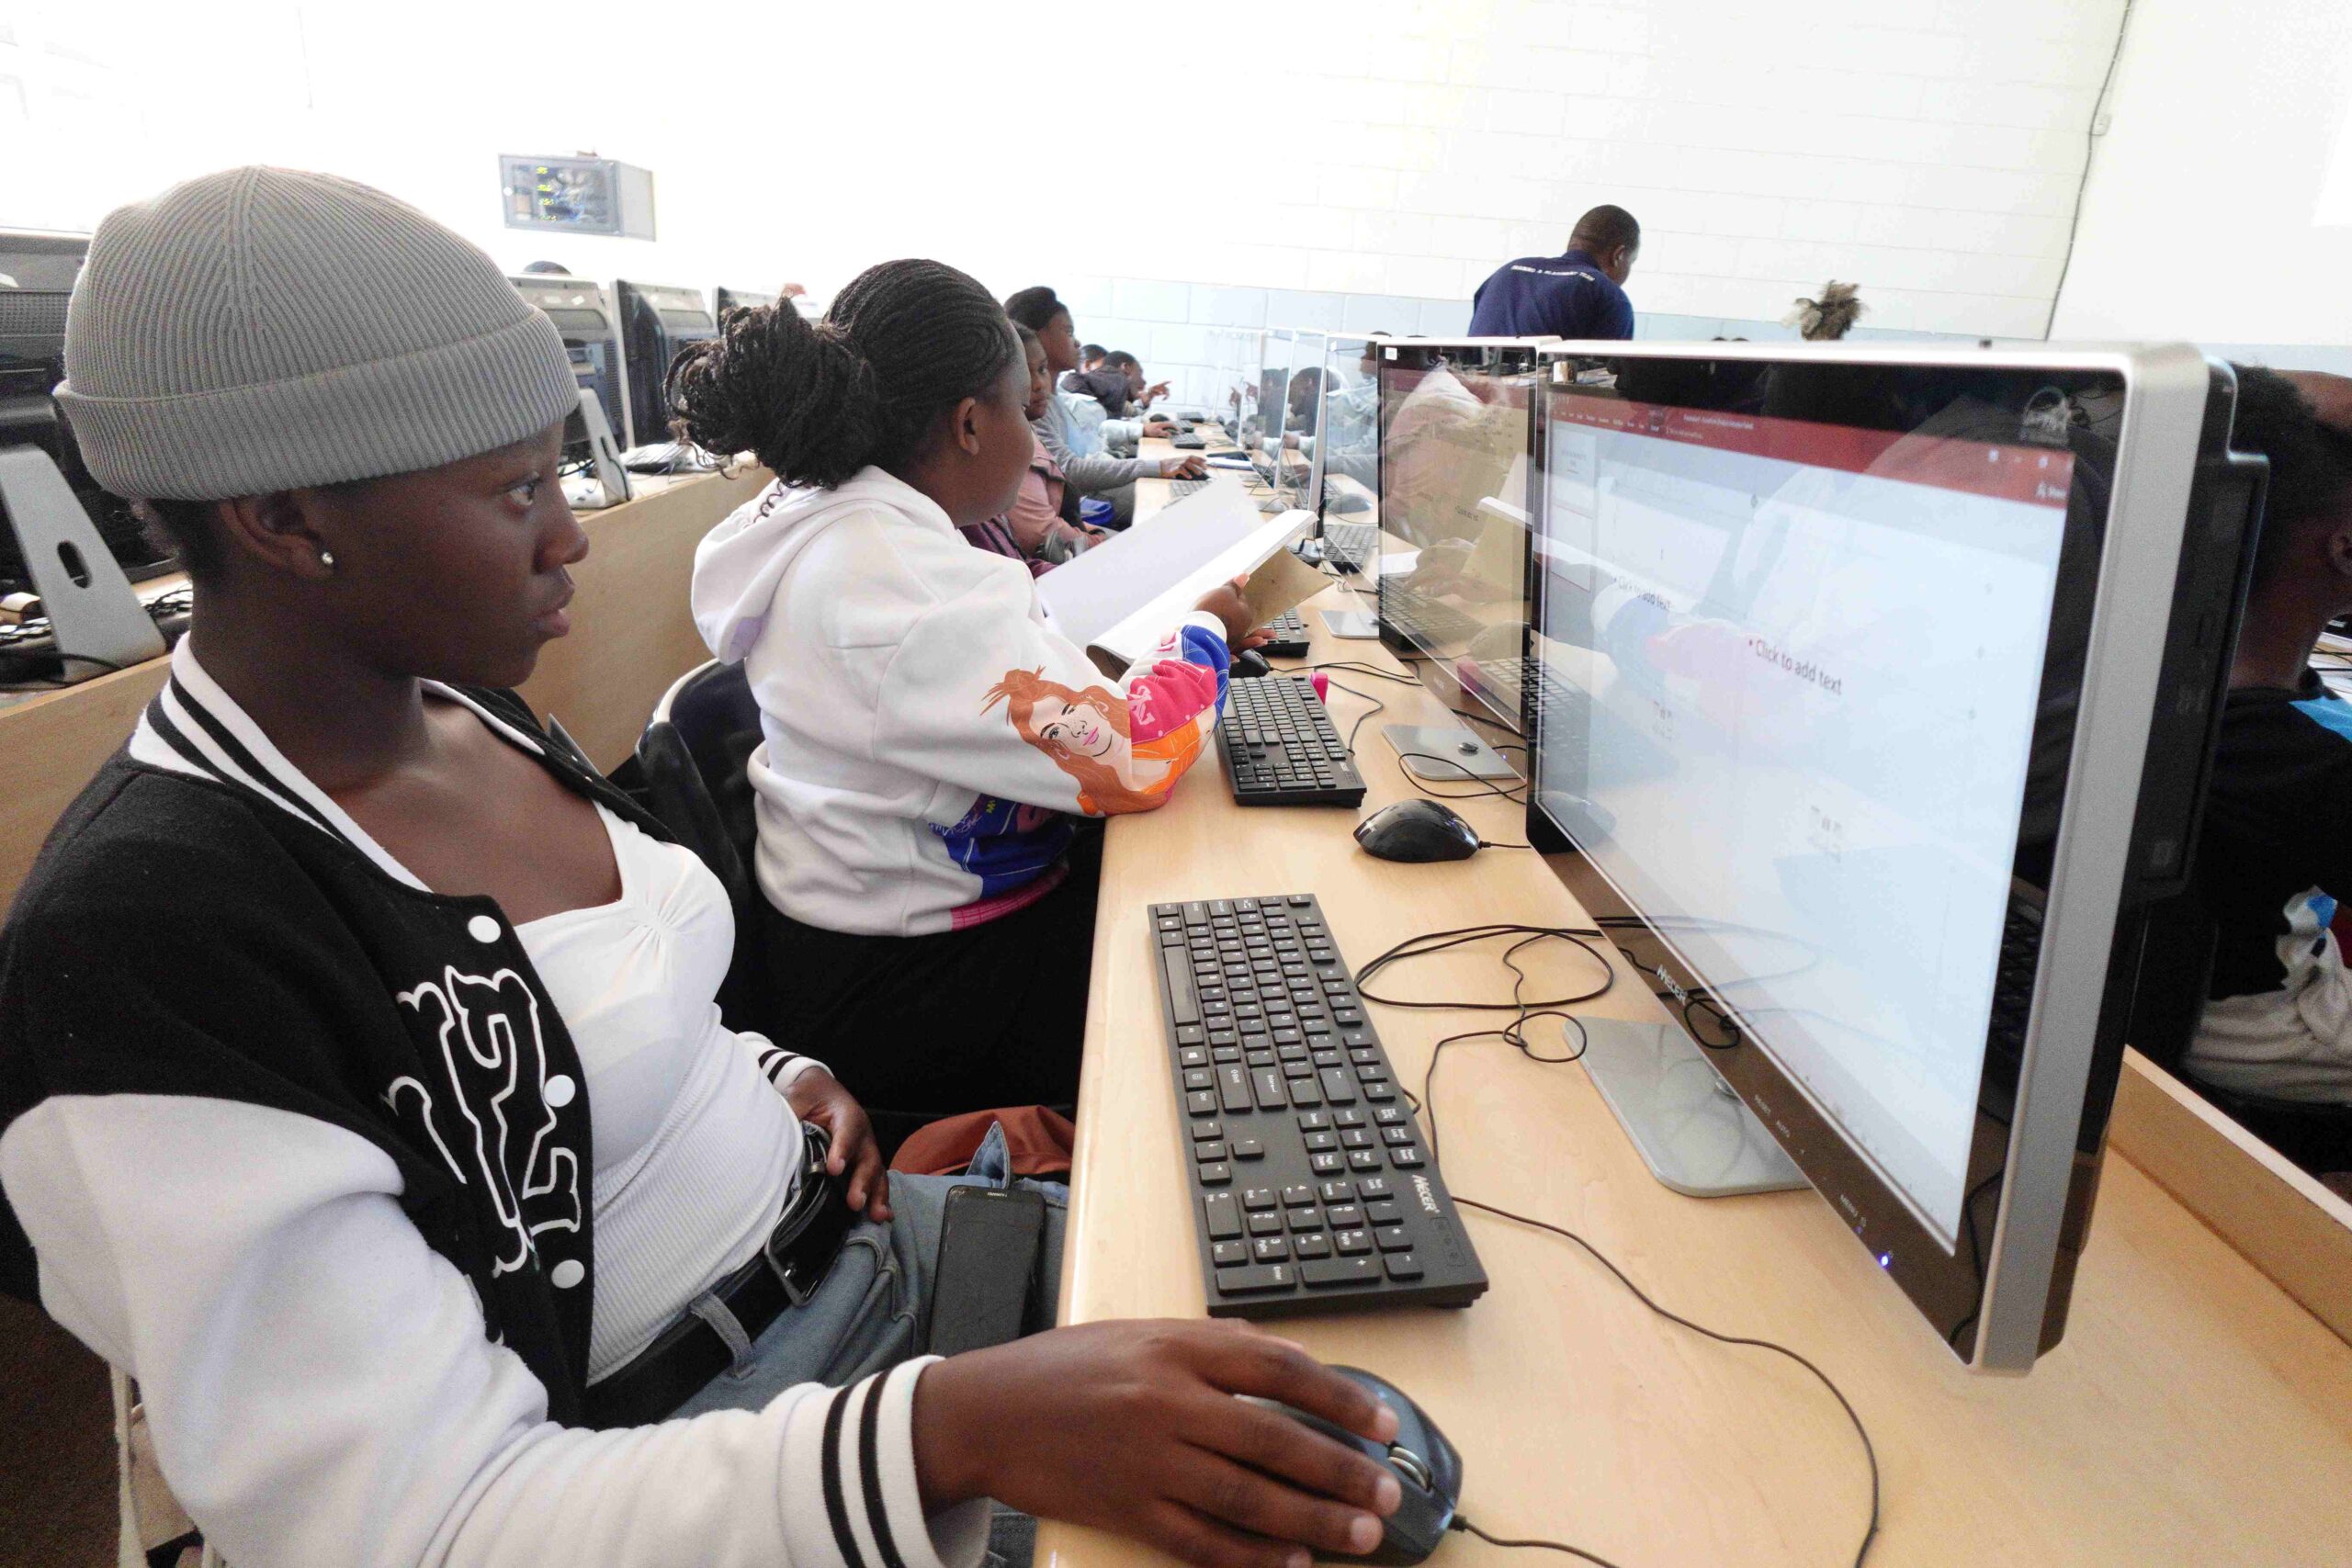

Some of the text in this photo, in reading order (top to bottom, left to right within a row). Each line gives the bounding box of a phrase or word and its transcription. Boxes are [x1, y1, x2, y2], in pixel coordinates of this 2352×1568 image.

[1756, 638, 1842, 696] Click to add text
[1657, 964, 1688, 1007] MECER
[1413, 1175, 1437, 1211] MECER
[1272, 1265, 1282, 1280] Enter
